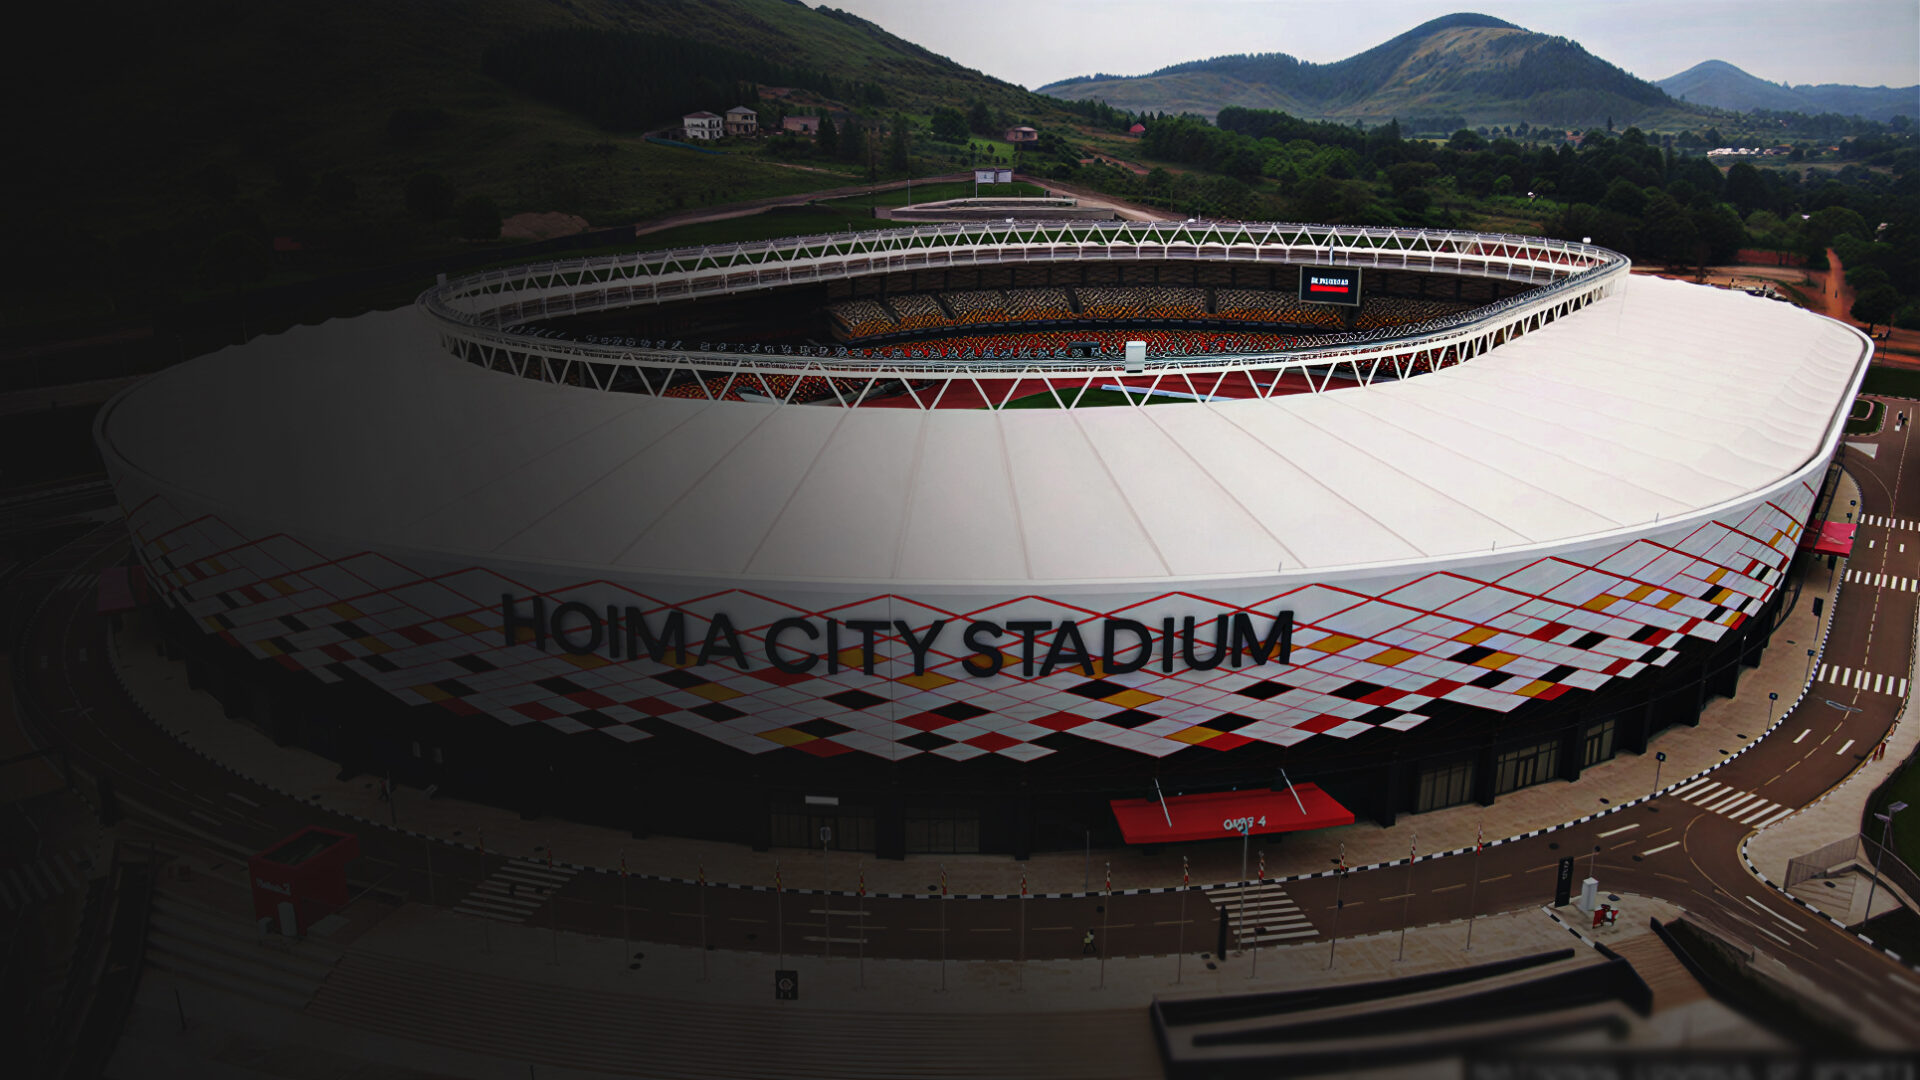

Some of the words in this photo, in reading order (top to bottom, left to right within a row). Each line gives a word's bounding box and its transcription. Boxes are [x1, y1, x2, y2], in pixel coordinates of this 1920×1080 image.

[503, 594, 749, 669] HOIMA
[764, 617, 946, 676] CITY
[961, 610, 1294, 678] STADIUM
